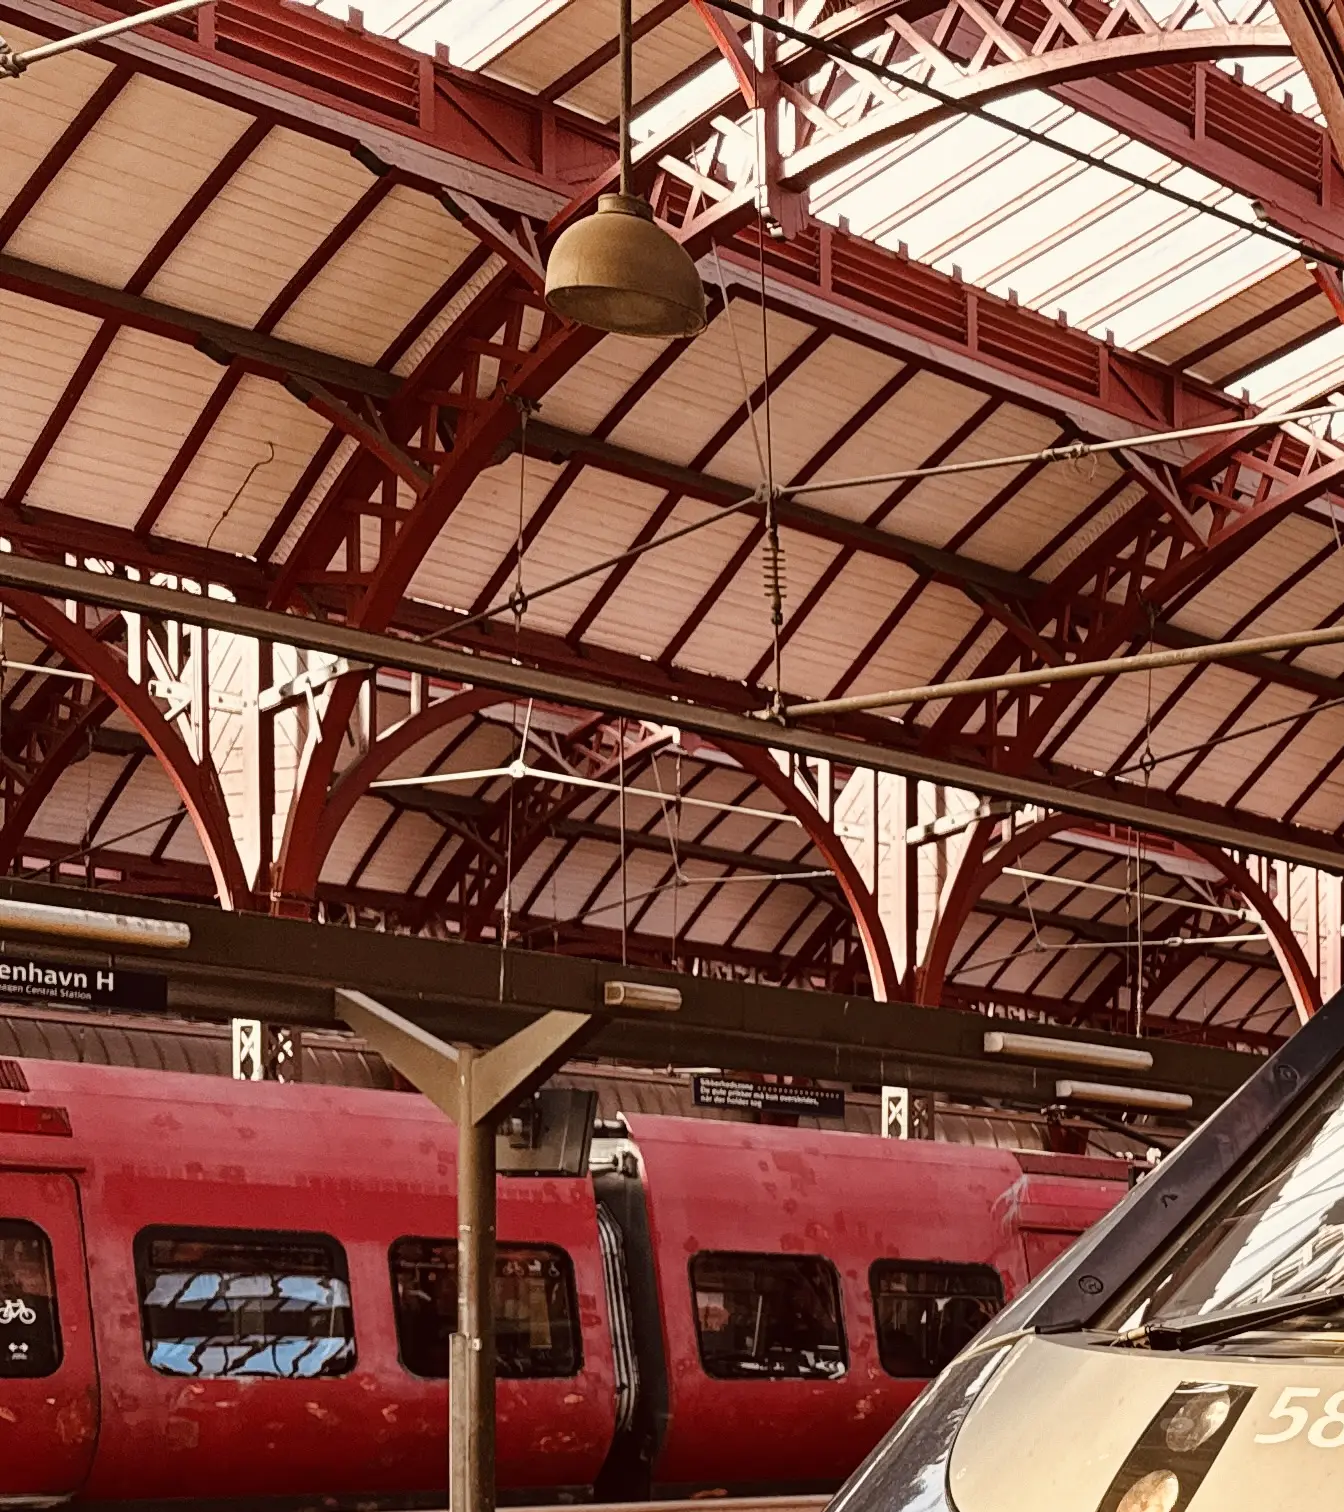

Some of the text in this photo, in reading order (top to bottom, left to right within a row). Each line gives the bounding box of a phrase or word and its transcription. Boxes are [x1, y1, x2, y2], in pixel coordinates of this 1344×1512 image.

[0, 962, 114, 992] enhavn H
[0, 984, 92, 1000] agen Central Station
